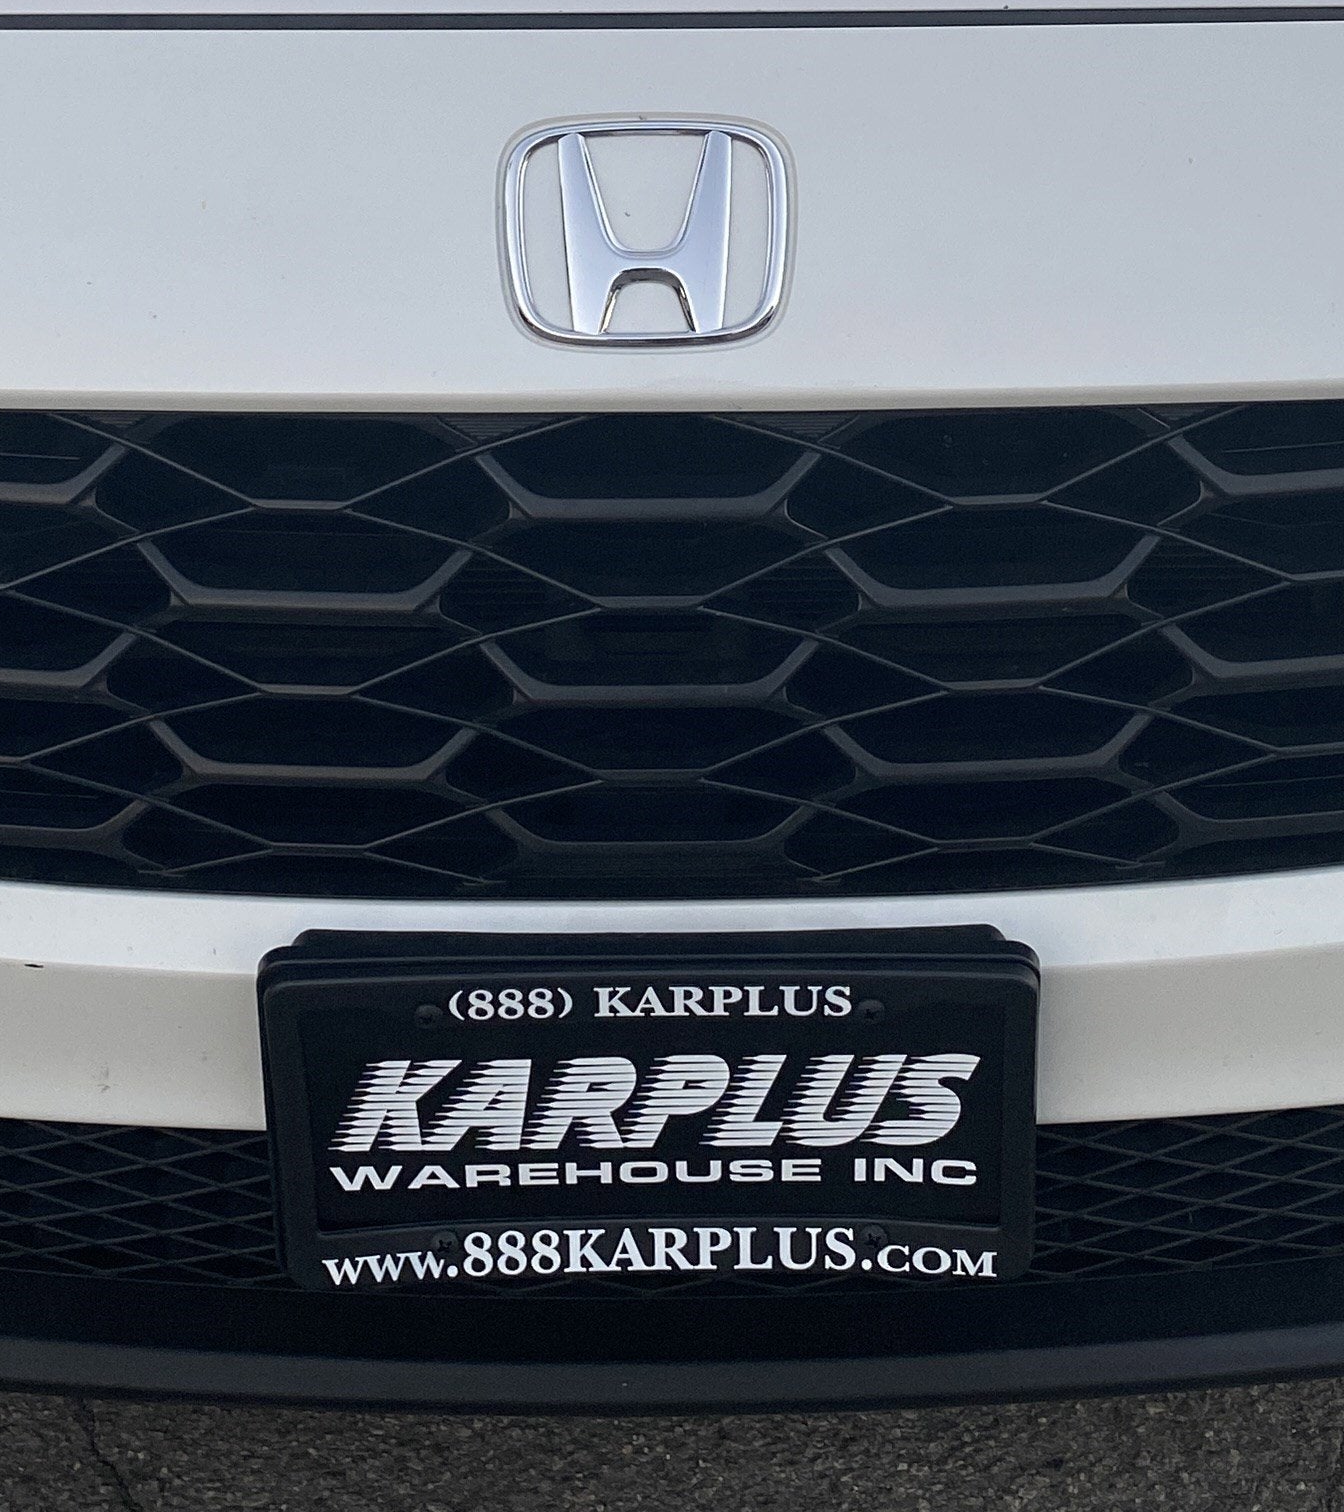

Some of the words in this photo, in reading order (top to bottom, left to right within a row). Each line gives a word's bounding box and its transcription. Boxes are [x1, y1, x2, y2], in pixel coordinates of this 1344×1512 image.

[448, 987, 573, 1021] (888)
[594, 985, 853, 1019] KARPLUS
[327, 1052, 982, 1153] KARPLUS
[329, 1159, 823, 1192] WAREHOUSE
[853, 1157, 979, 1187] INC
